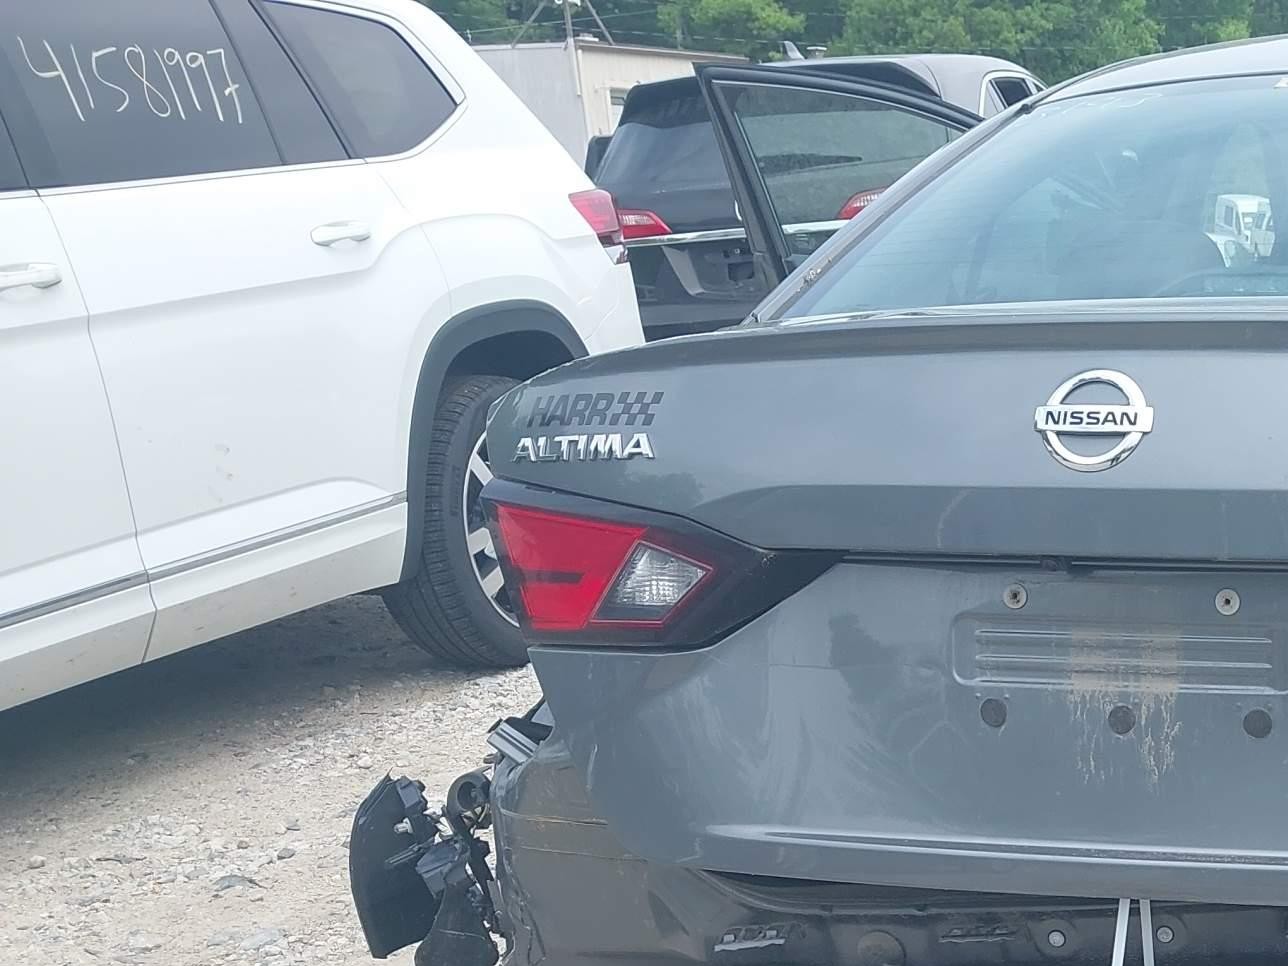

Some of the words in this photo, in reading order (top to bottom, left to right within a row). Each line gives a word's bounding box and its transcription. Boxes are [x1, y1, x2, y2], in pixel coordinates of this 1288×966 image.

[16, 35, 243, 124] 41581997
[1045, 410, 1138, 426] NISSAN
[511, 432, 656, 464] ALTIMA
